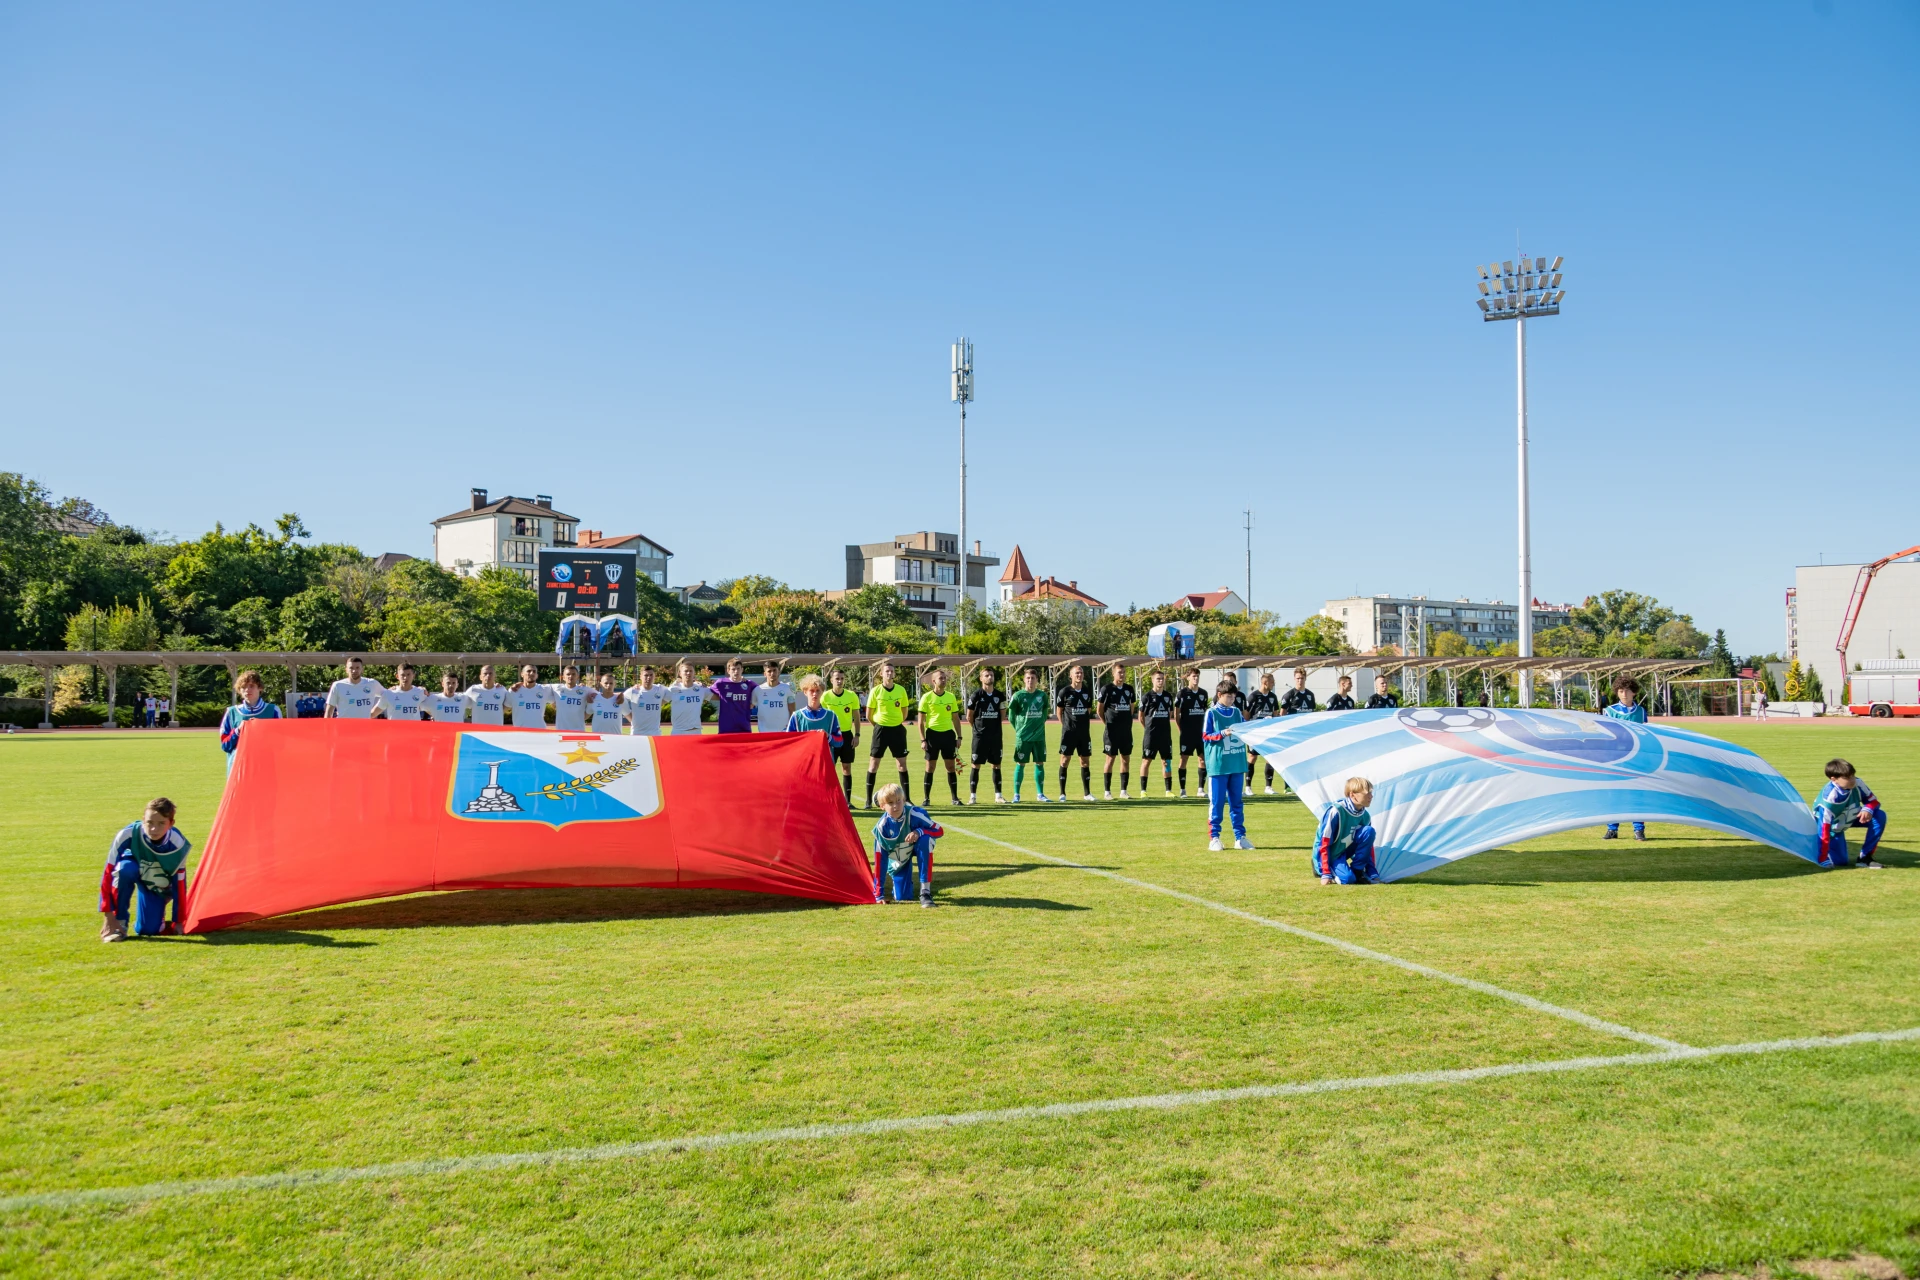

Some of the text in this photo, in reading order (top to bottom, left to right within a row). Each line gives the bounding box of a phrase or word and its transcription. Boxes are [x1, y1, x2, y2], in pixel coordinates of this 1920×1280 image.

[577, 586, 598, 594] 00:00
[556, 592, 567, 608] 0
[608, 593, 619, 609] 0
[686, 695, 700, 703] ВТБ
[732, 693, 747, 701] ВТБ
[356, 699, 371, 707] ВТБ
[566, 697, 581, 706] ВТБ
[769, 700, 783, 708] ВТБ
[402, 706, 418, 714] ВТБ
[483, 703, 499, 711] ВТБ
[525, 702, 541, 710] ВТБ
[645, 703, 659, 711] ВТБ
[603, 711, 618, 719] ВТБ
